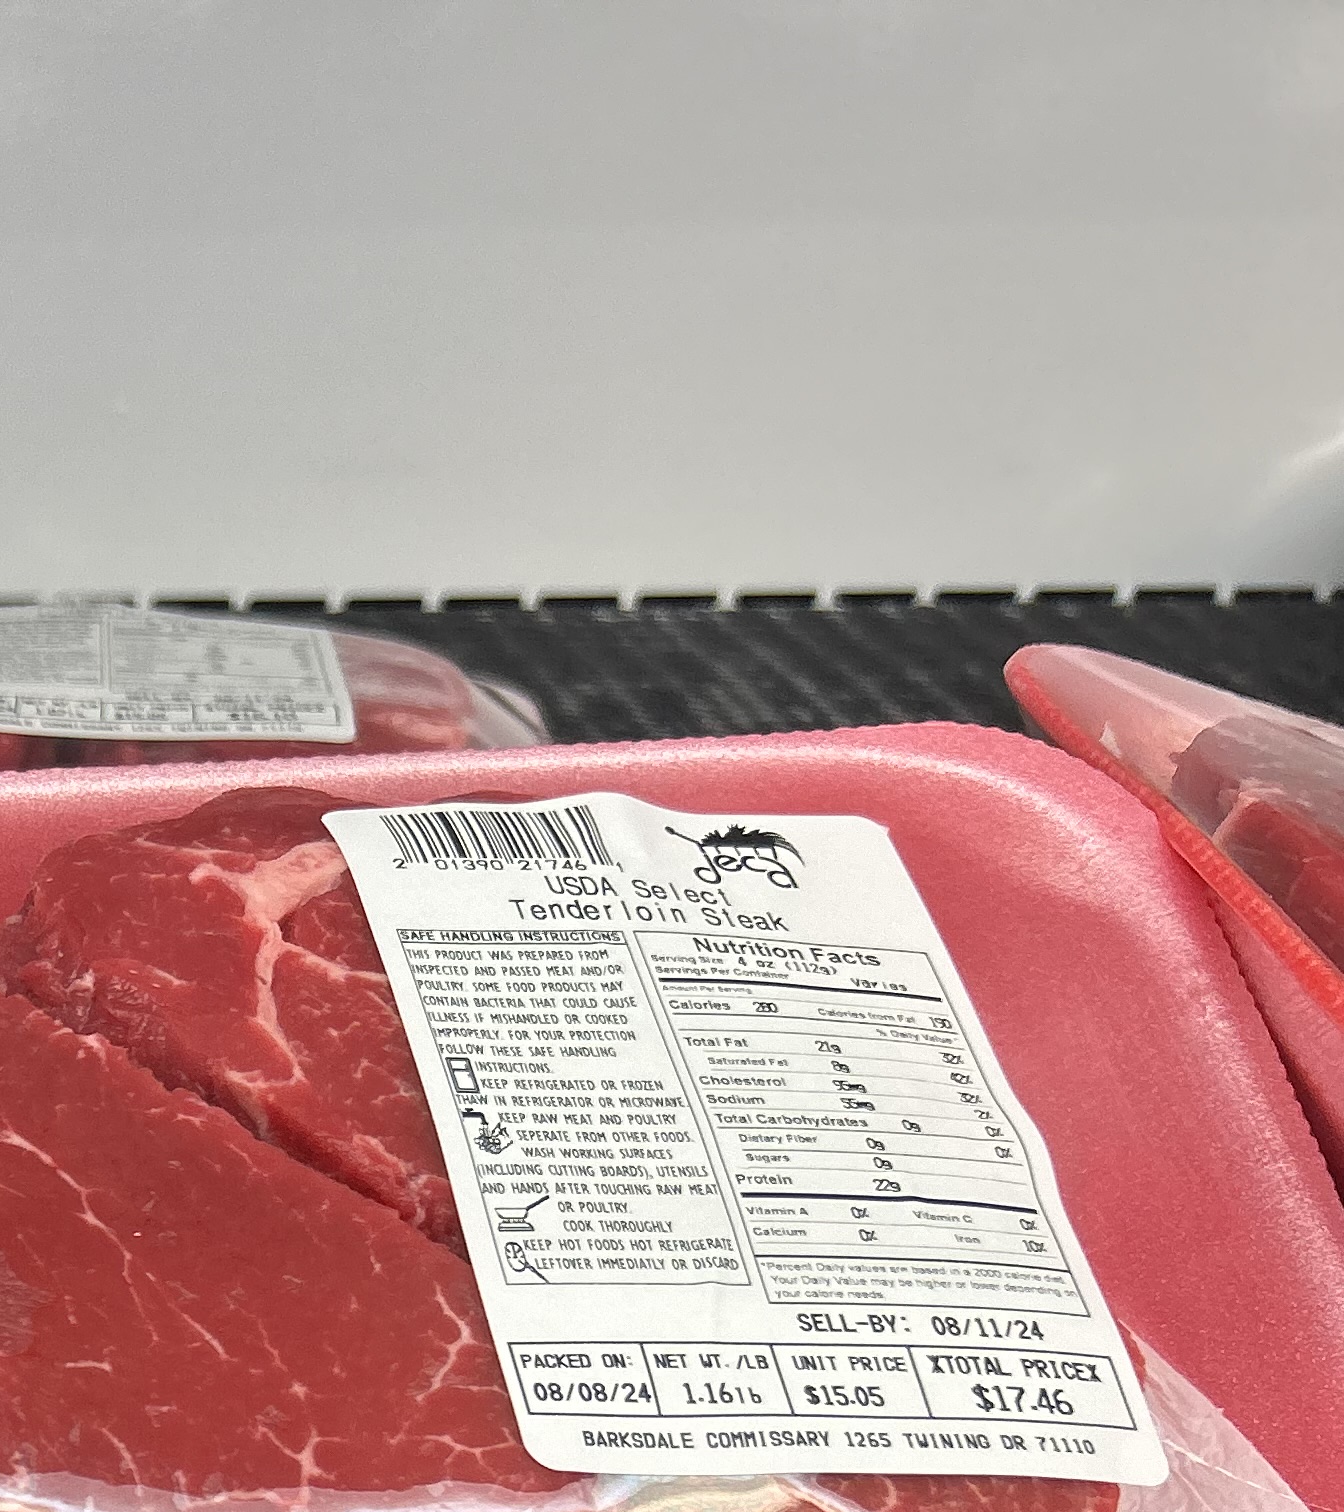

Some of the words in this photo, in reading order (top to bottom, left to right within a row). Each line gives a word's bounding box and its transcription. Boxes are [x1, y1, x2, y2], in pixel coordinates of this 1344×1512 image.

[393, 854, 411, 869] 2
[434, 859, 503, 870] 01390
[518, 860, 587, 870] 21746
[614, 861, 624, 873] 1
[544, 876, 618, 896] USDA
[632, 876, 731, 906] Select
[509, 900, 686, 923] Tenderloin
[701, 908, 789, 931] Steak
[400, 931, 436, 942] SAFE
[440, 931, 513, 942] HANDLING
[519, 931, 621, 942] INSTRUCTIONS
[693, 936, 804, 961] Nutrition
[812, 946, 881, 967] Facts
[481, 1079, 508, 1091] KEEP
[514, 1079, 595, 1090] REFRIGERATED
[601, 1080, 617, 1090] OR
[621, 1080, 663, 1091] FROZEN
[498, 1112, 526, 1124] KEEP
[532, 1113, 557, 1124] RAW
[564, 1113, 593, 1124] MEAT
[599, 1113, 622, 1125] AND
[627, 1114, 676, 1125] POULTRY
[516, 1130, 570, 1142] SEPERATE
[576, 1132, 607, 1142] FROM
[612, 1132, 650, 1142] OTHER
[521, 1147, 555, 1158] WASH
[559, 1148, 614, 1159] WORKING
[620, 1148, 672, 1159] SURFACES
[477, 1163, 543, 1178] (INCLUDING
[548, 1165, 595, 1177] CUTTING
[656, 1166, 708, 1177] UTENSILS
[481, 1182, 505, 1194] AND
[511, 1182, 549, 1193] HANDS
[556, 1183, 590, 1194] AFTER
[594, 1184, 651, 1195] TOUCHING
[656, 1185, 681, 1195] RAW
[688, 1184, 719, 1196] MEAT
[558, 1201, 575, 1212] OR
[563, 1220, 593, 1232] COOK
[598, 1220, 672, 1232] THOROUGHLY
[523, 1239, 552, 1251] KEEP
[558, 1239, 580, 1250] HOT
[585, 1239, 624, 1250] FOODS
[630, 1240, 652, 1251] HOT
[658, 1238, 734, 1251] REFRIGERATE
[535, 1258, 593, 1270] LEFTOVER
[597, 1258, 664, 1270] IMMEDIATLY
[672, 1259, 688, 1270] OR
[692, 1257, 739, 1270] DISCARD
[797, 1314, 910, 1332] SELL-BY:
[931, 1316, 1044, 1340] 08/11/24
[520, 1354, 591, 1368] PACKED
[602, 1354, 632, 1368] ON:
[653, 1354, 687, 1368] NET
[699, 1354, 729, 1368] WT.
[737, 1355, 769, 1369] /LB
[792, 1356, 840, 1370] UNIT
[848, 1357, 907, 1372] PRICE
[533, 1382, 653, 1404] 08/08/24
[804, 1385, 884, 1407] $15.05
[972, 1384, 1073, 1415] $17.46
[582, 1431, 694, 1448] BARKSDALE
[706, 1431, 829, 1448] COMMISSARY
[844, 1432, 891, 1447] 1265
[903, 1433, 990, 1449] TWINING
[1000, 1435, 1027, 1450] DR
[1035, 1437, 1095, 1454] 71110
